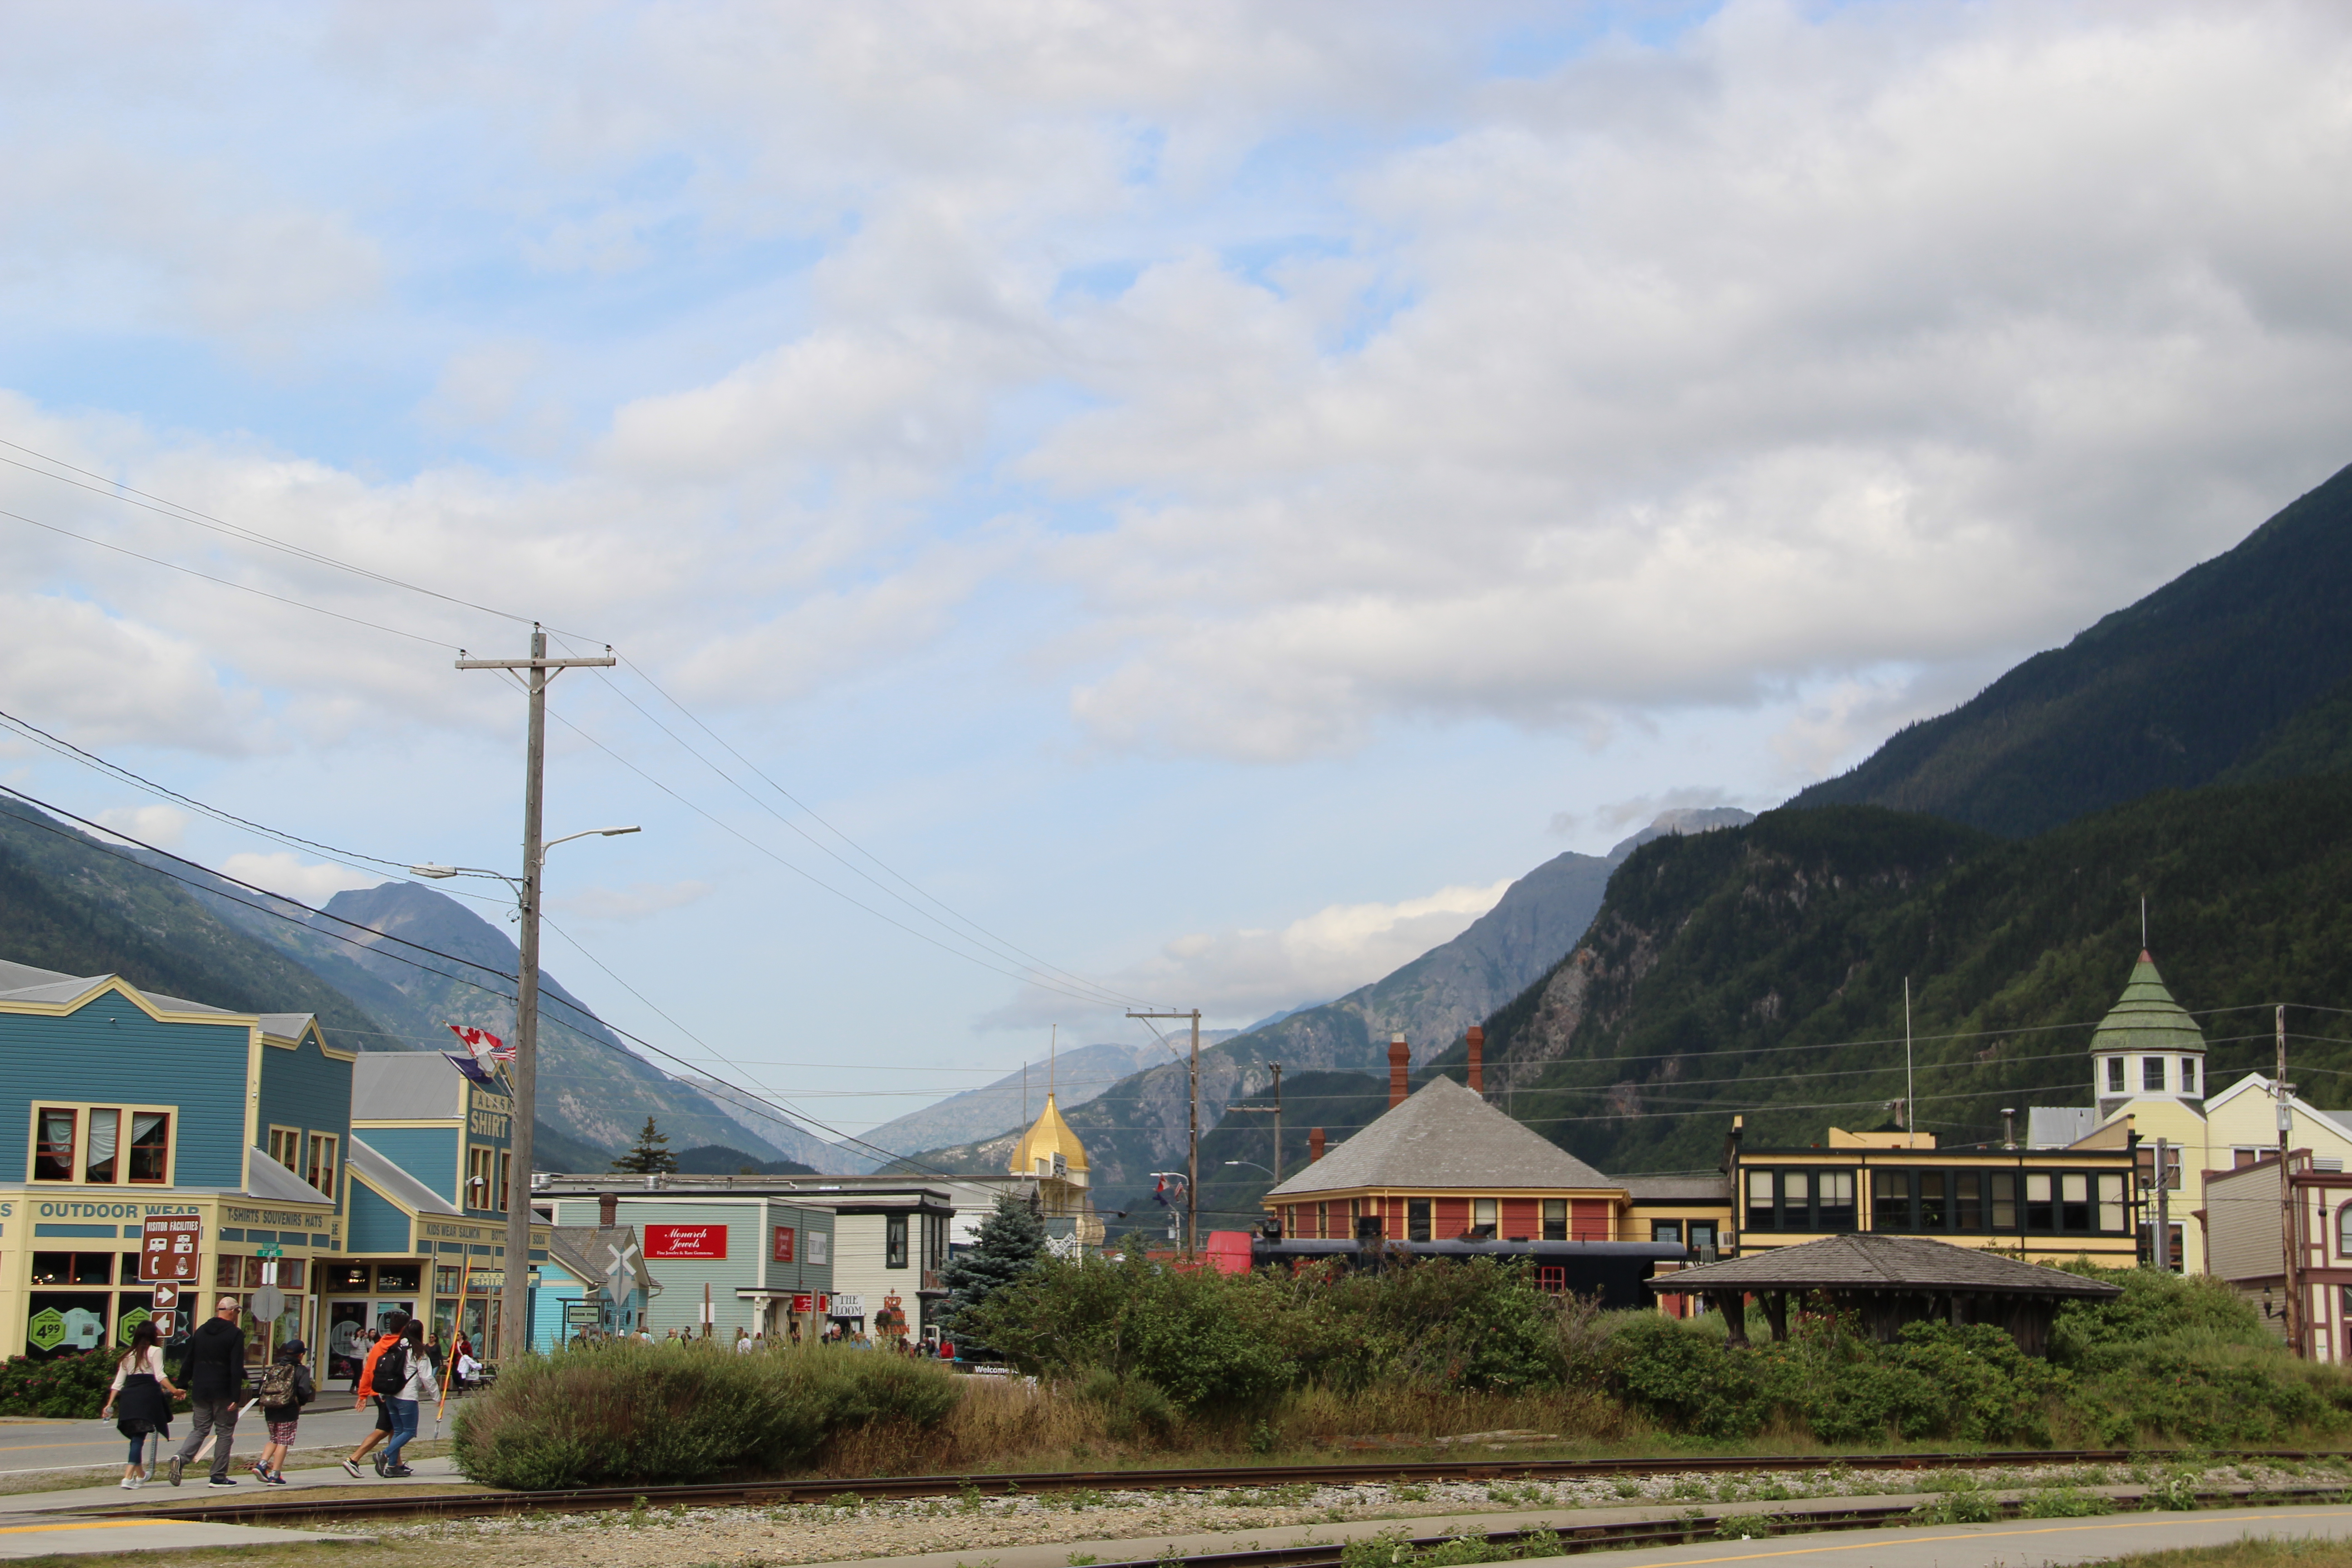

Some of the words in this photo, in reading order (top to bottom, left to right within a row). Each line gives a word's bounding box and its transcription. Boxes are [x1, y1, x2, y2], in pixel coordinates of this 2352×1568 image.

[478, 1094, 512, 1112] ALASK
[470, 1110, 508, 1138] SHIRT
[40, 1203, 138, 1218] OUTDOOR
[228, 1208, 259, 1223] T-SHIRTS
[263, 1211, 302, 1226] SOUVENIRS
[305, 1215, 323, 1228] HATS
[147, 1222, 168, 1232] VISITOR
[170, 1221, 199, 1231] FACILITIES
[664, 1228, 707, 1238] Monarch
[427, 1224, 440, 1235] KIDS
[441, 1225, 456, 1237] WEAR
[459, 1227, 480, 1240] SALMON
[491, 1230, 508, 1241] BOTTL
[533, 1234, 545, 1245] SODA
[669, 1238, 700, 1251] Jewels
[1046, 1238, 1056, 1249] AIL
[1054, 1234, 1074, 1254] SSING
[839, 1295, 858, 1304] THE
[835, 1306, 862, 1315] LOOM
[975, 1366, 1009, 1374] Welcome
